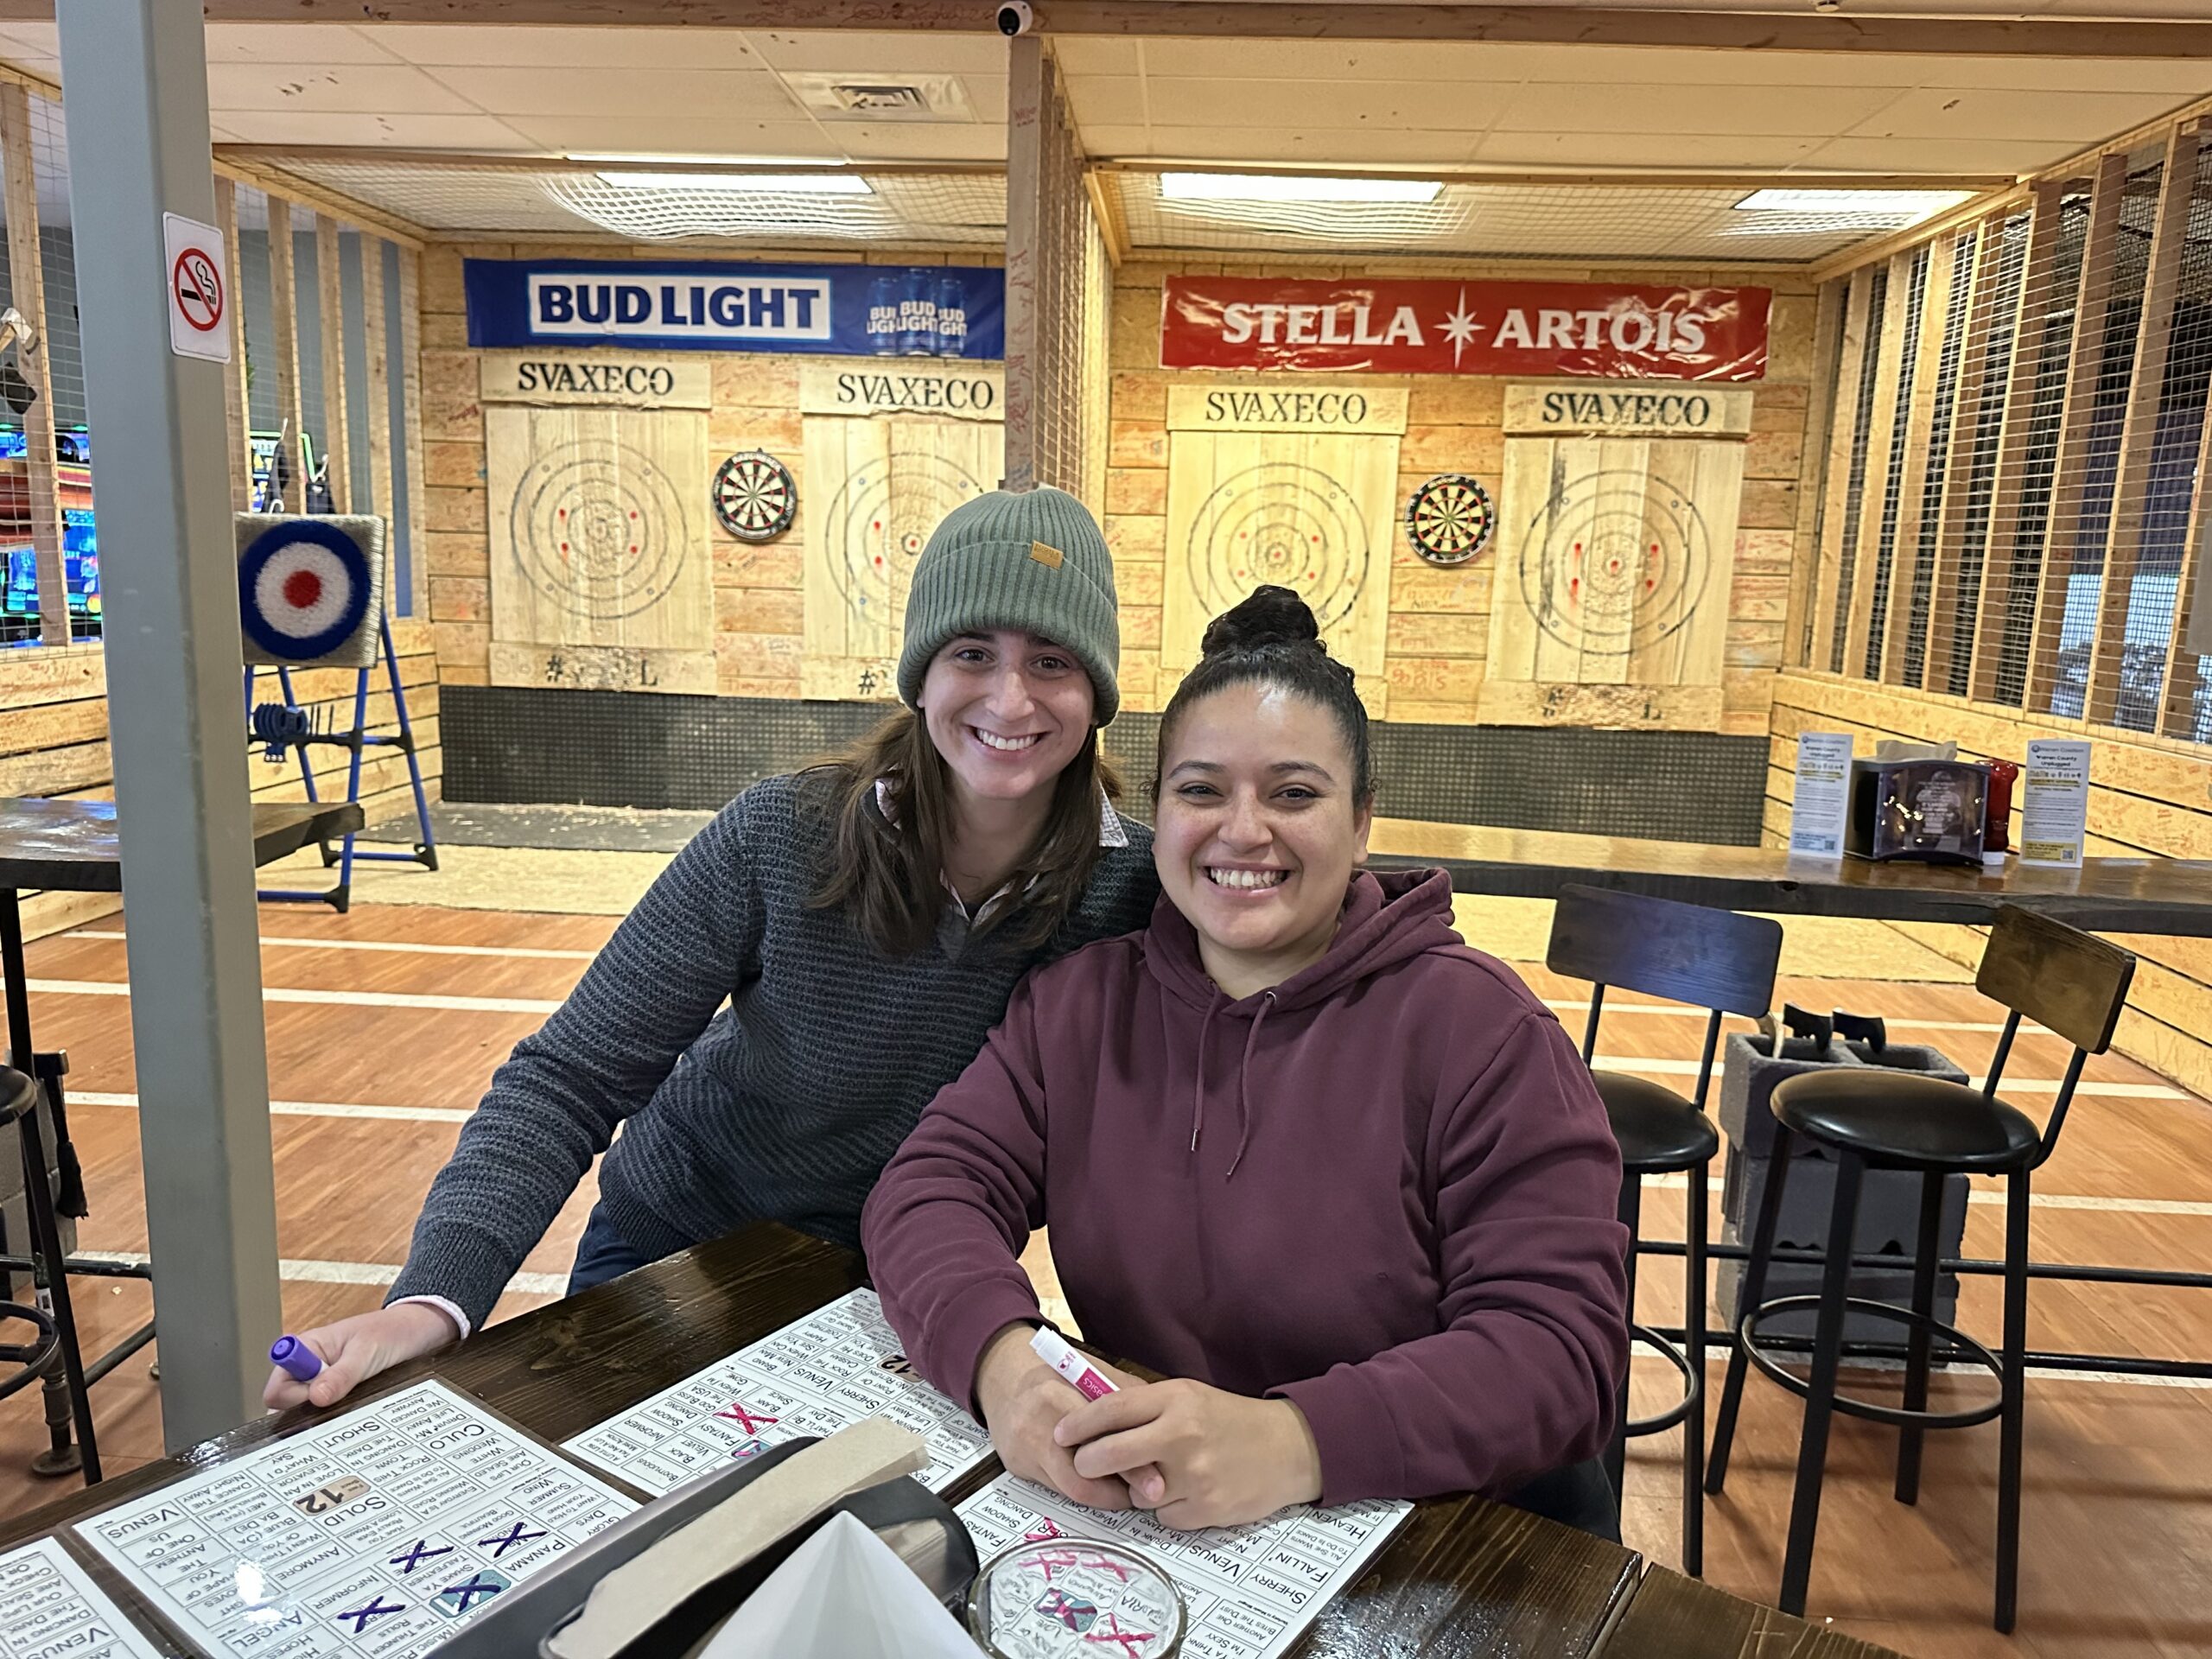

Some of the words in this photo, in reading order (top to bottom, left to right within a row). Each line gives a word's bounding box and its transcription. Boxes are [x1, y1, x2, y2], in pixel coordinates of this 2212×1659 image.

[538, 284, 652, 324] BUD
[661, 286, 821, 329] LIGHT
[900, 301, 936, 317] BUD
[1222, 303, 1426, 346] STELLA
[1492, 308, 1707, 353] ARTOIS
[518, 362, 674, 397] SVAXECO
[837, 373, 995, 410] SVAXECO
[1205, 391, 1367, 425] SVAXECO
[793, 1368, 833, 1390] VENUS
[1083, 1377, 1103, 1397] asics
[838, 1387, 880, 1409] SHERRY
[324, 1421, 380, 1447] SHOUT
[372, 1434, 395, 1446] THE
[429, 1423, 485, 1449] CULO
[623, 1418, 664, 1441] INFORMER
[700, 1423, 741, 1446] FANTASY
[271, 1452, 294, 1465] SAY
[345, 1443, 373, 1458] DARK
[363, 1439, 407, 1460] DANCING
[452, 1437, 500, 1459] WEDDING
[470, 1446, 505, 1464] WHITE
[374, 1453, 409, 1469] TOWN
[399, 1454, 431, 1471] ROCK
[277, 1462, 330, 1487] ELEVATOR
[314, 1467, 345, 1483] LOVE
[372, 1469, 402, 1483] THIS
[523, 1478, 553, 1494] WIND
[283, 1485, 301, 1497] AN
[296, 1488, 343, 1513] 12
[528, 1482, 571, 1505] SUMMER
[323, 1496, 386, 1526] SOLID
[575, 1509, 606, 1526] DAYS
[982, 1505, 1020, 1529] SHADOW
[995, 1496, 1033, 1520] DANCING
[107, 1508, 179, 1538] VENUS
[1128, 1526, 1141, 1536] IN
[1311, 1510, 1366, 1539] HEAVEN
[148, 1531, 171, 1542] US
[1140, 1531, 1172, 1550] DRINK
[1215, 1535, 1248, 1554] NIGHT
[155, 1543, 206, 1568] ANTHEM
[178, 1559, 207, 1573] THE
[276, 1546, 340, 1580] ANYMORE
[505, 1539, 566, 1571] PANAMA
[1188, 1544, 1240, 1577] VENUS
[188, 1568, 220, 1583] YOU
[1268, 1552, 1328, 1582] FALLIN'
[313, 1574, 379, 1609] INFORMER
[1250, 1573, 1306, 1605] SHERRY
[414, 1618, 438, 1630] THE
[371, 1629, 417, 1655] THUNDER
